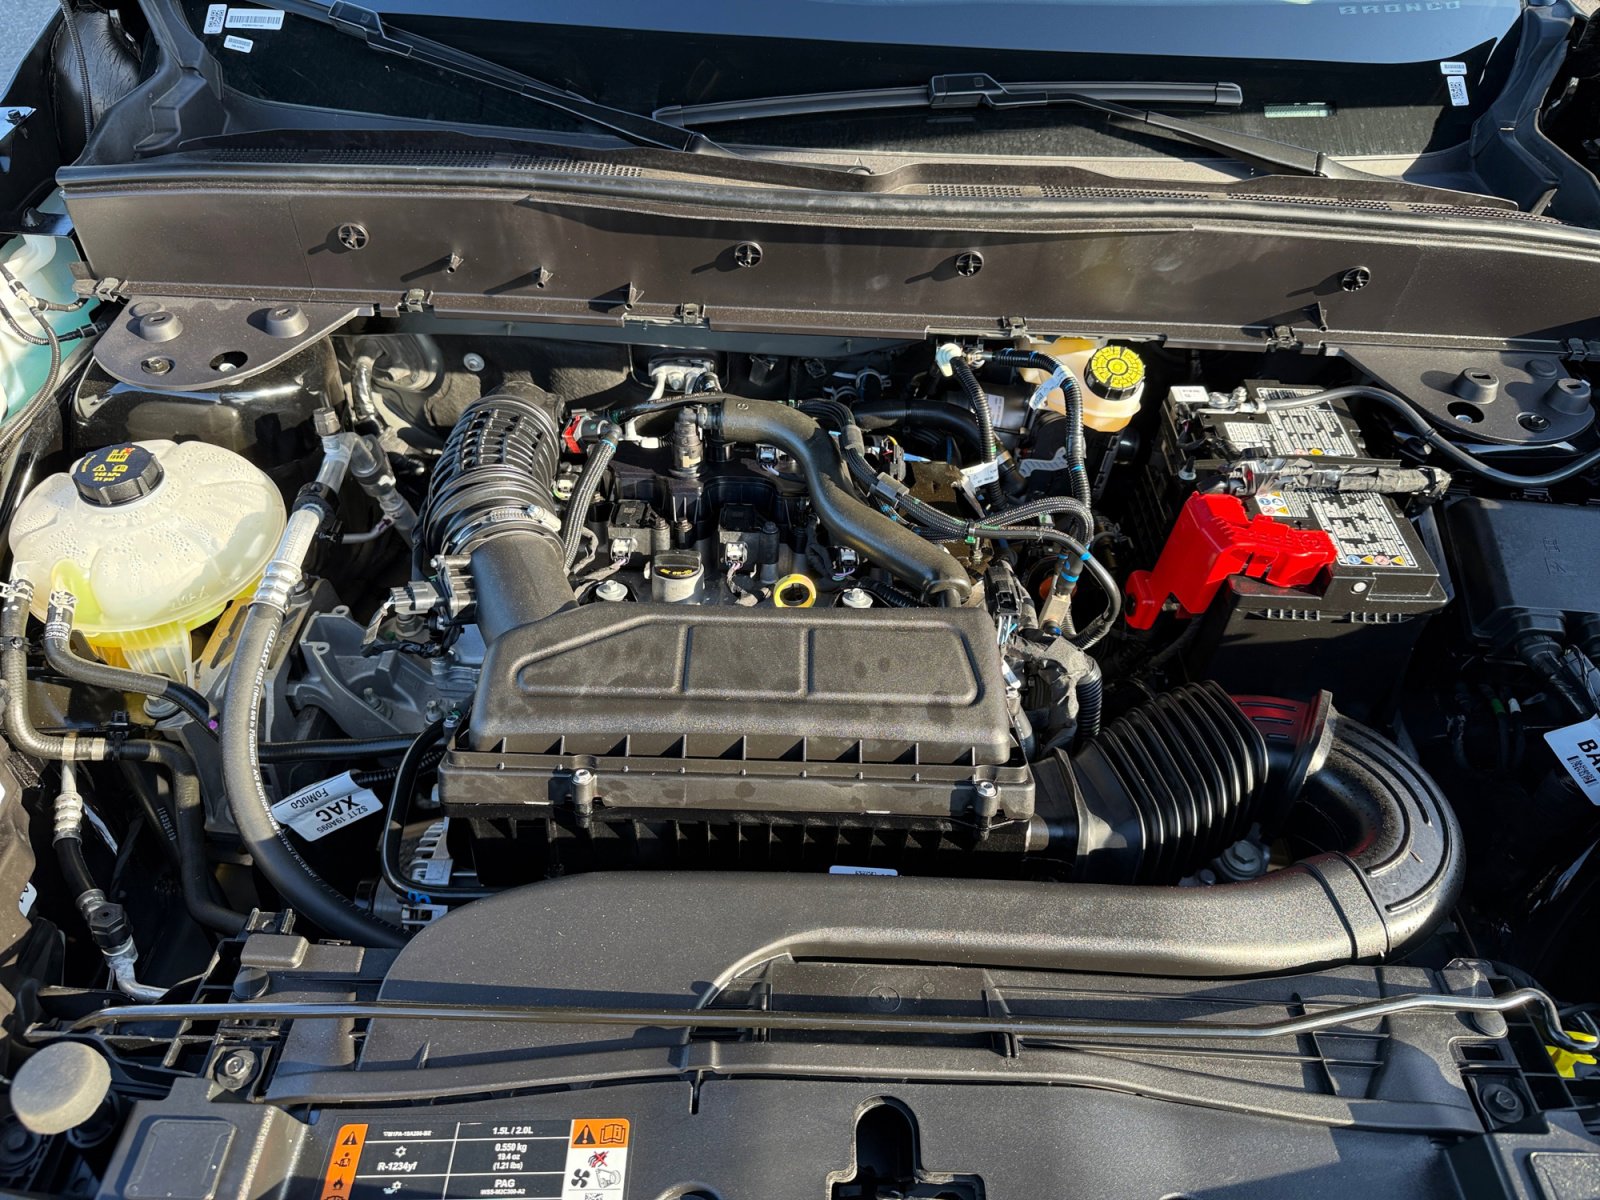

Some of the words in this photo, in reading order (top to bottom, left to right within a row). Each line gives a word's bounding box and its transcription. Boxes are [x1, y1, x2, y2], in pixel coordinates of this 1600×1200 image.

[1338, 0, 1461, 15] BRONCO
[260, 630, 276, 666] GALAXY
[1577, 739, 1600, 774] BA
[290, 787, 329, 810] FoMoCo
[315, 794, 361, 823] XAC
[266, 811, 280, 831] HOSE
[492, 1127, 510, 1135] 1.5L
[515, 1126, 534, 1135] 2.0L
[494, 1142, 516, 1152] 0.550
[516, 1142, 528, 1153] kg
[376, 1161, 418, 1172] R-1234yf
[494, 1179, 516, 1188] PAG
